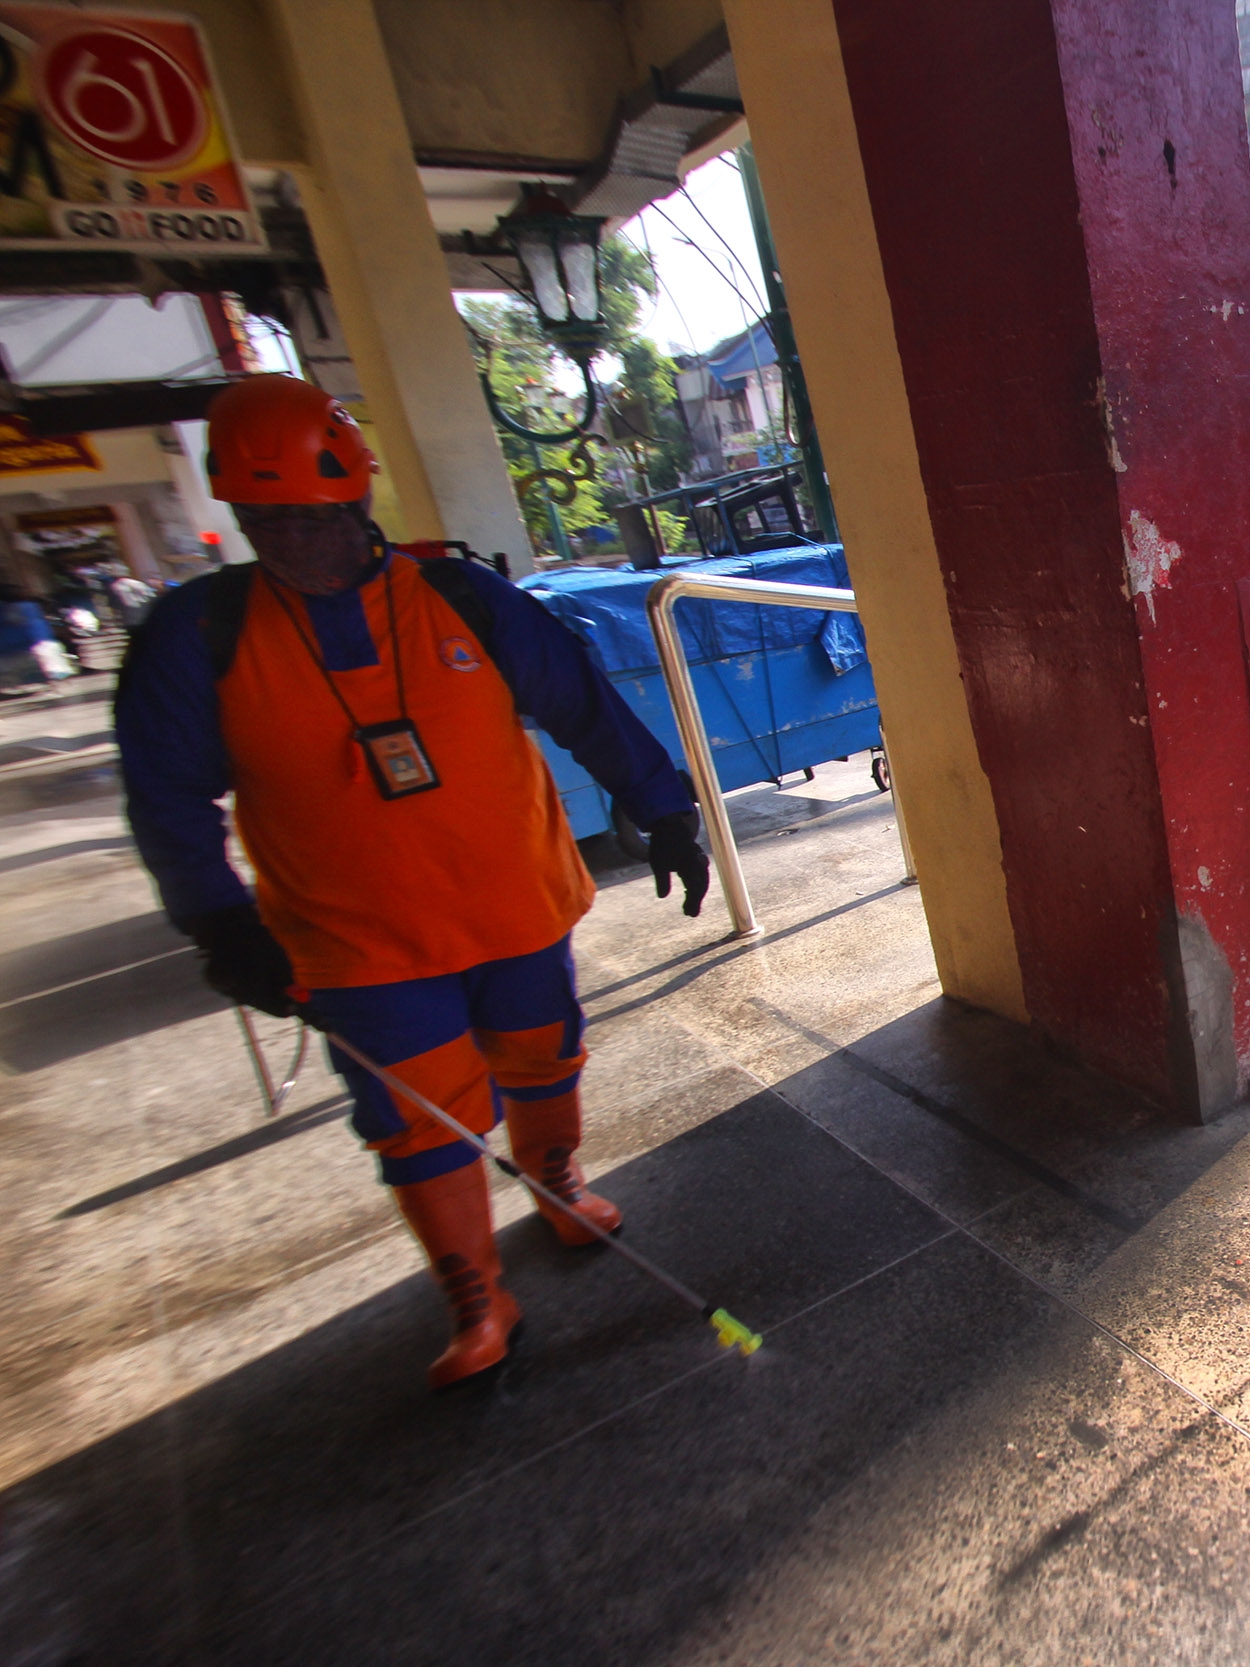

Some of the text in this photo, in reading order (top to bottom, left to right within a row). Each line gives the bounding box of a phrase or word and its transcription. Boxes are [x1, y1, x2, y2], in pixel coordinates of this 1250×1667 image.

[60, 49, 179, 147] 61
[65, 209, 246, 242] GO FOOD
